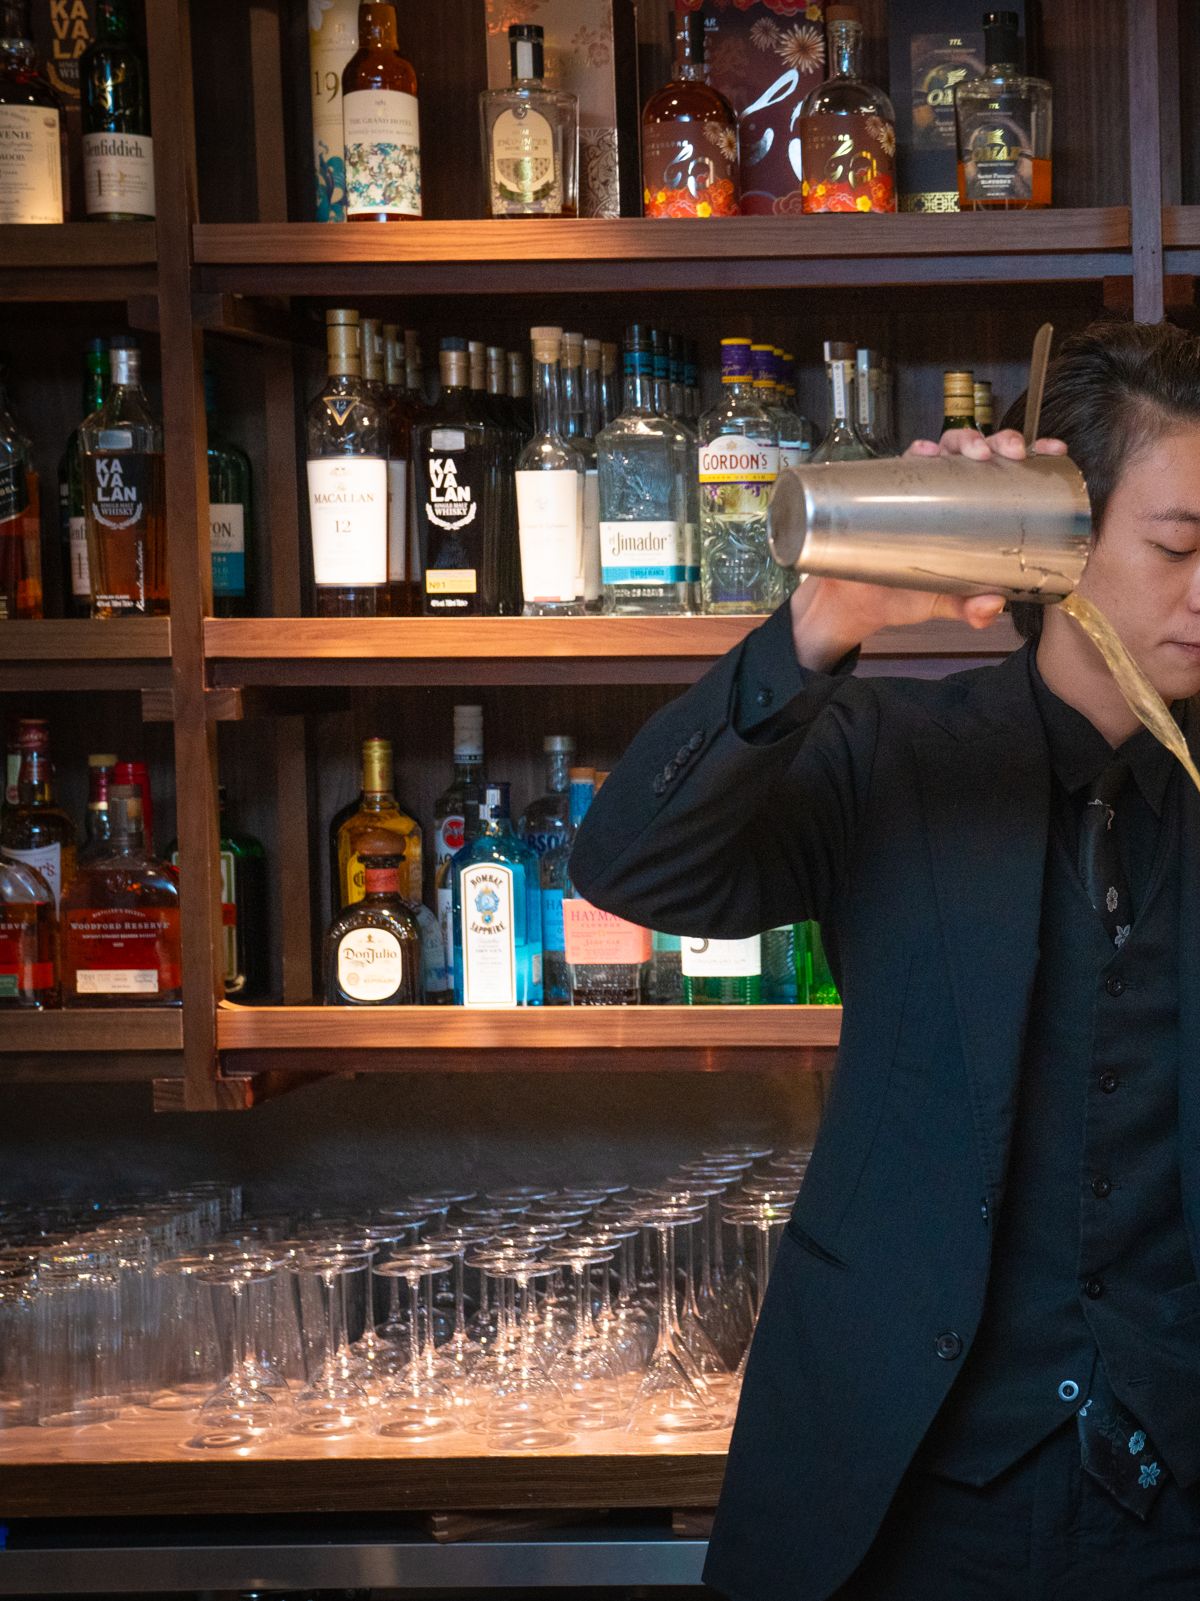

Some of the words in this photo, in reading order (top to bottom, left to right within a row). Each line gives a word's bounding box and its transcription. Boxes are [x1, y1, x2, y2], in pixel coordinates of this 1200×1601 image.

[52, 20, 90, 39] VA
[53, 39, 88, 59] LA
[96, 458, 123, 474] KA
[429, 458, 457, 474] KA
[703, 452, 768, 471] GORDON'S
[97, 473, 123, 488] VA
[430, 473, 457, 488] VA
[97, 487, 137, 502] LAN
[313, 492, 375, 504] MACALLAN
[431, 486, 471, 502] LAN
[101, 507, 134, 516] WHISKY
[435, 508, 468, 516] WHISKY
[335, 520, 352, 533] 12
[612, 531, 667, 556] Jimador
[470, 873, 504, 888] BOMBAY
[571, 911, 622, 921] HAYMA
[71, 922, 122, 931] WOODFORD
[124, 921, 170, 930] RESERVE
[470, 920, 506, 936] SAPPHIRE
